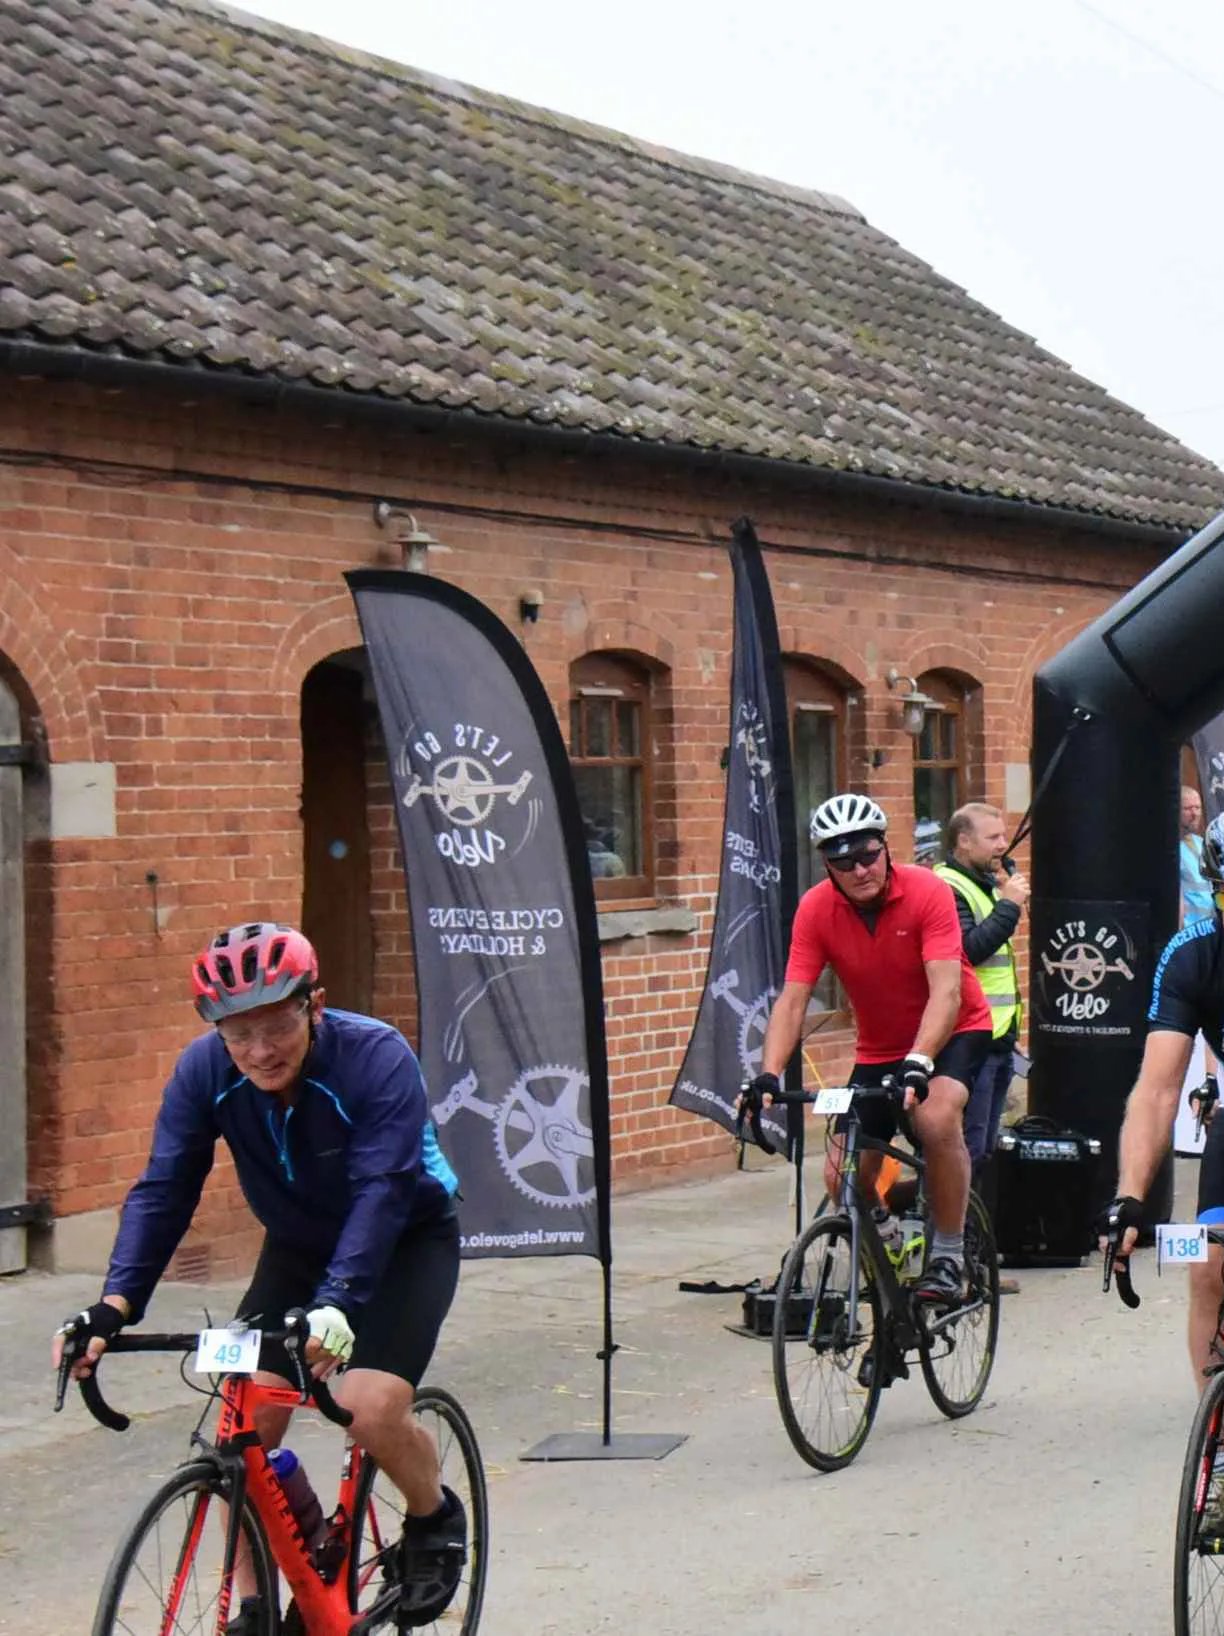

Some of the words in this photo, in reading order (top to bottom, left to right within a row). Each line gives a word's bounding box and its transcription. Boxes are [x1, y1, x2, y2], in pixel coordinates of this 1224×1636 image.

[1049, 920, 1086, 950] LET'S
[1095, 927, 1118, 949] GO
[1196, 919, 1216, 936] UK
[1055, 991, 1110, 1020] Velo
[1166, 1238, 1199, 1256] 138
[214, 1343, 241, 1364] 49
